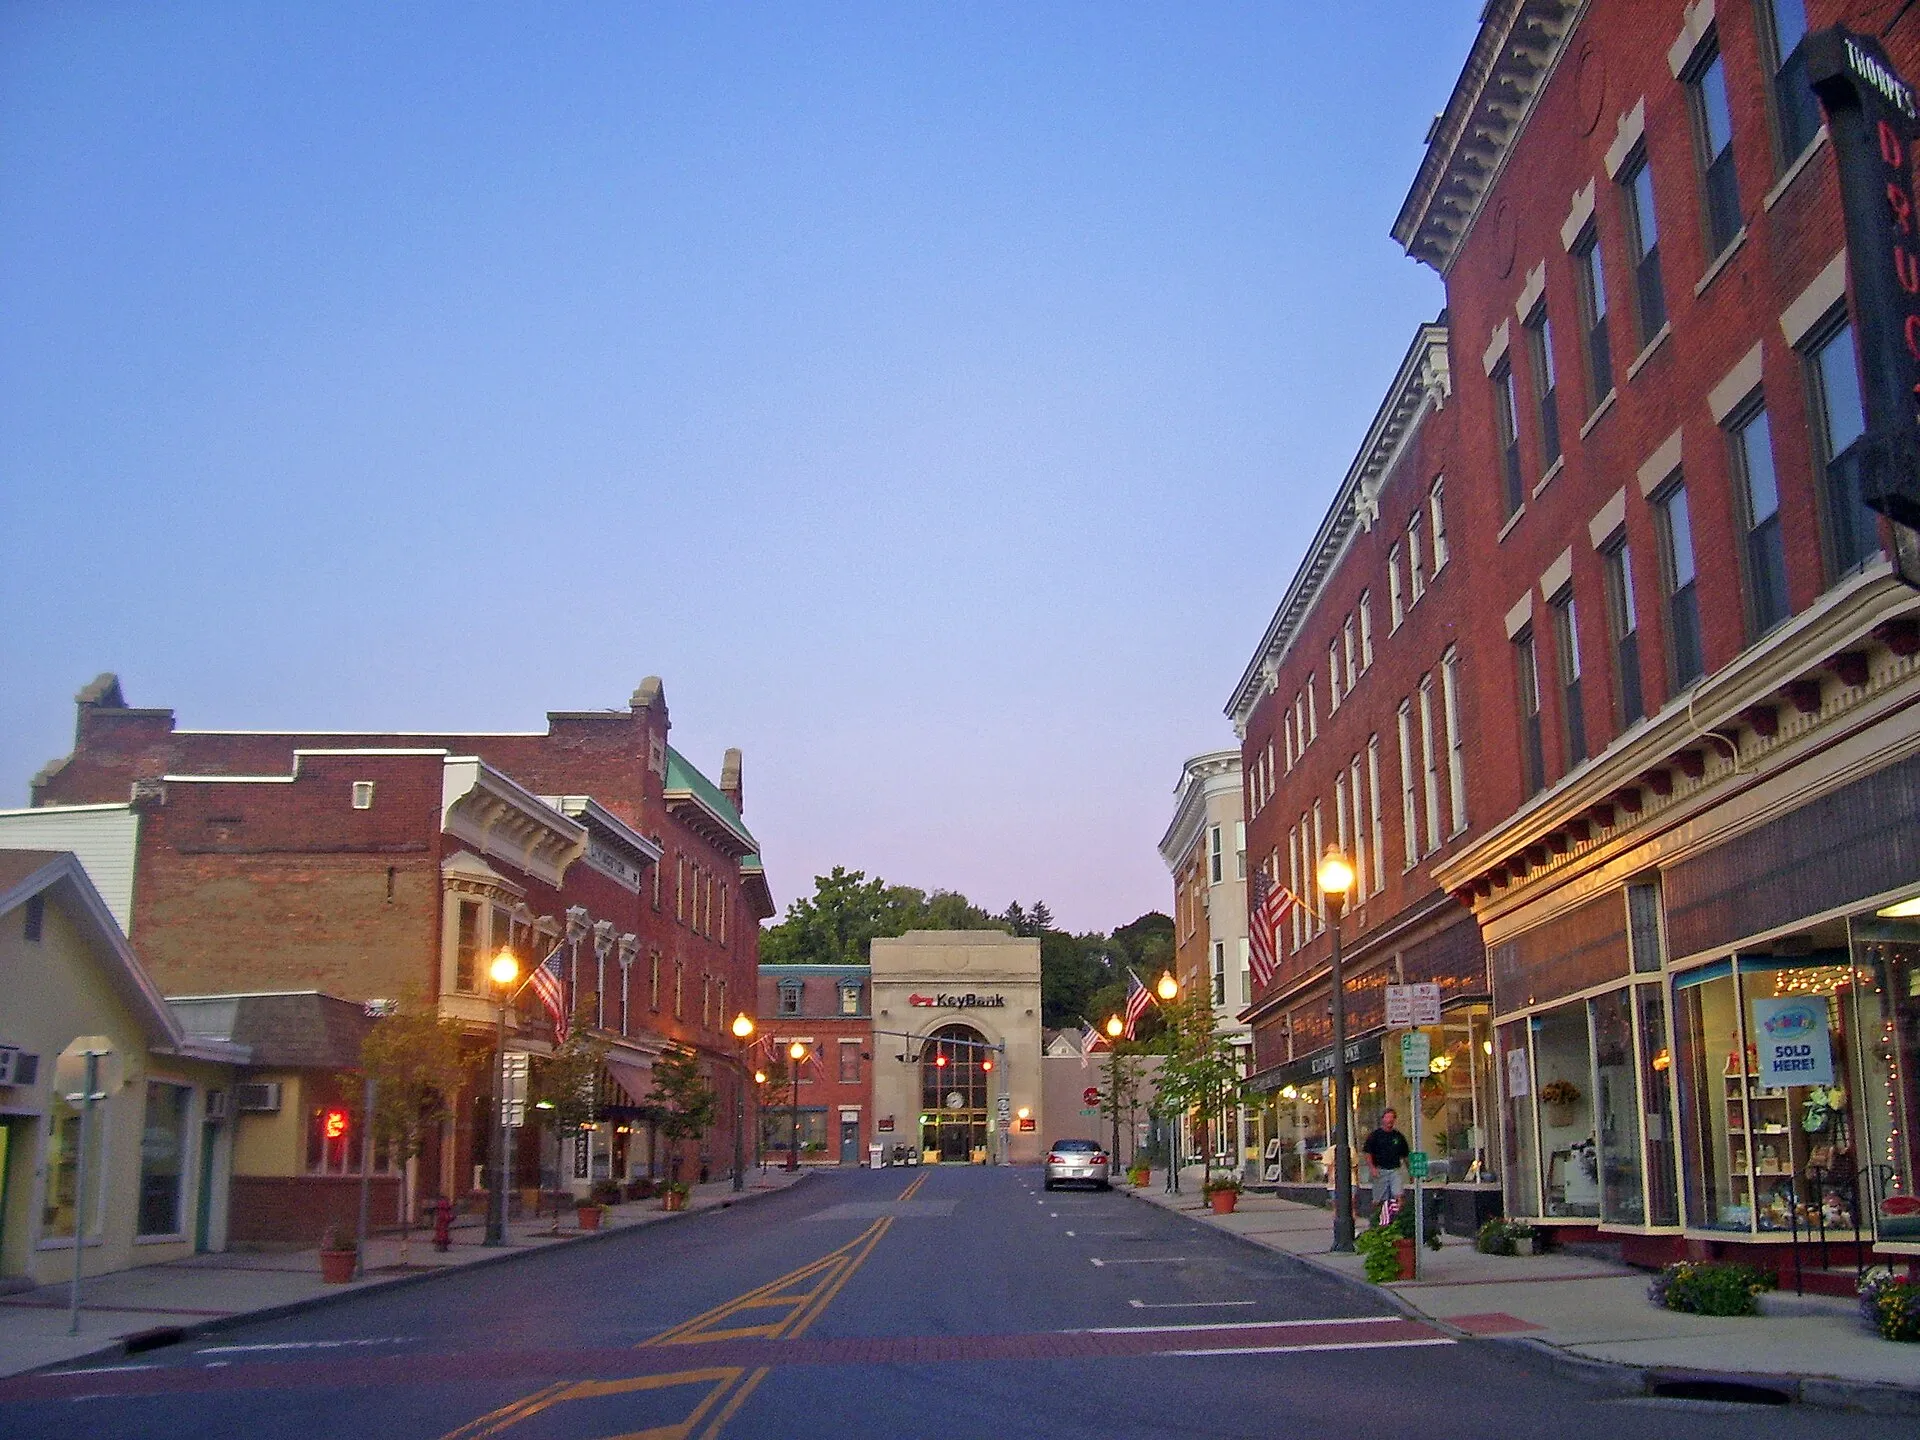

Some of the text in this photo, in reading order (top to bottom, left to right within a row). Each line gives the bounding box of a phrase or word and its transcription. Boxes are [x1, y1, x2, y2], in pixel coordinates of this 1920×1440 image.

[937, 993, 1004, 1009] KeyBank
[1775, 1045, 1811, 1058] SOLD
[1773, 1058, 1815, 1072] HERE!
